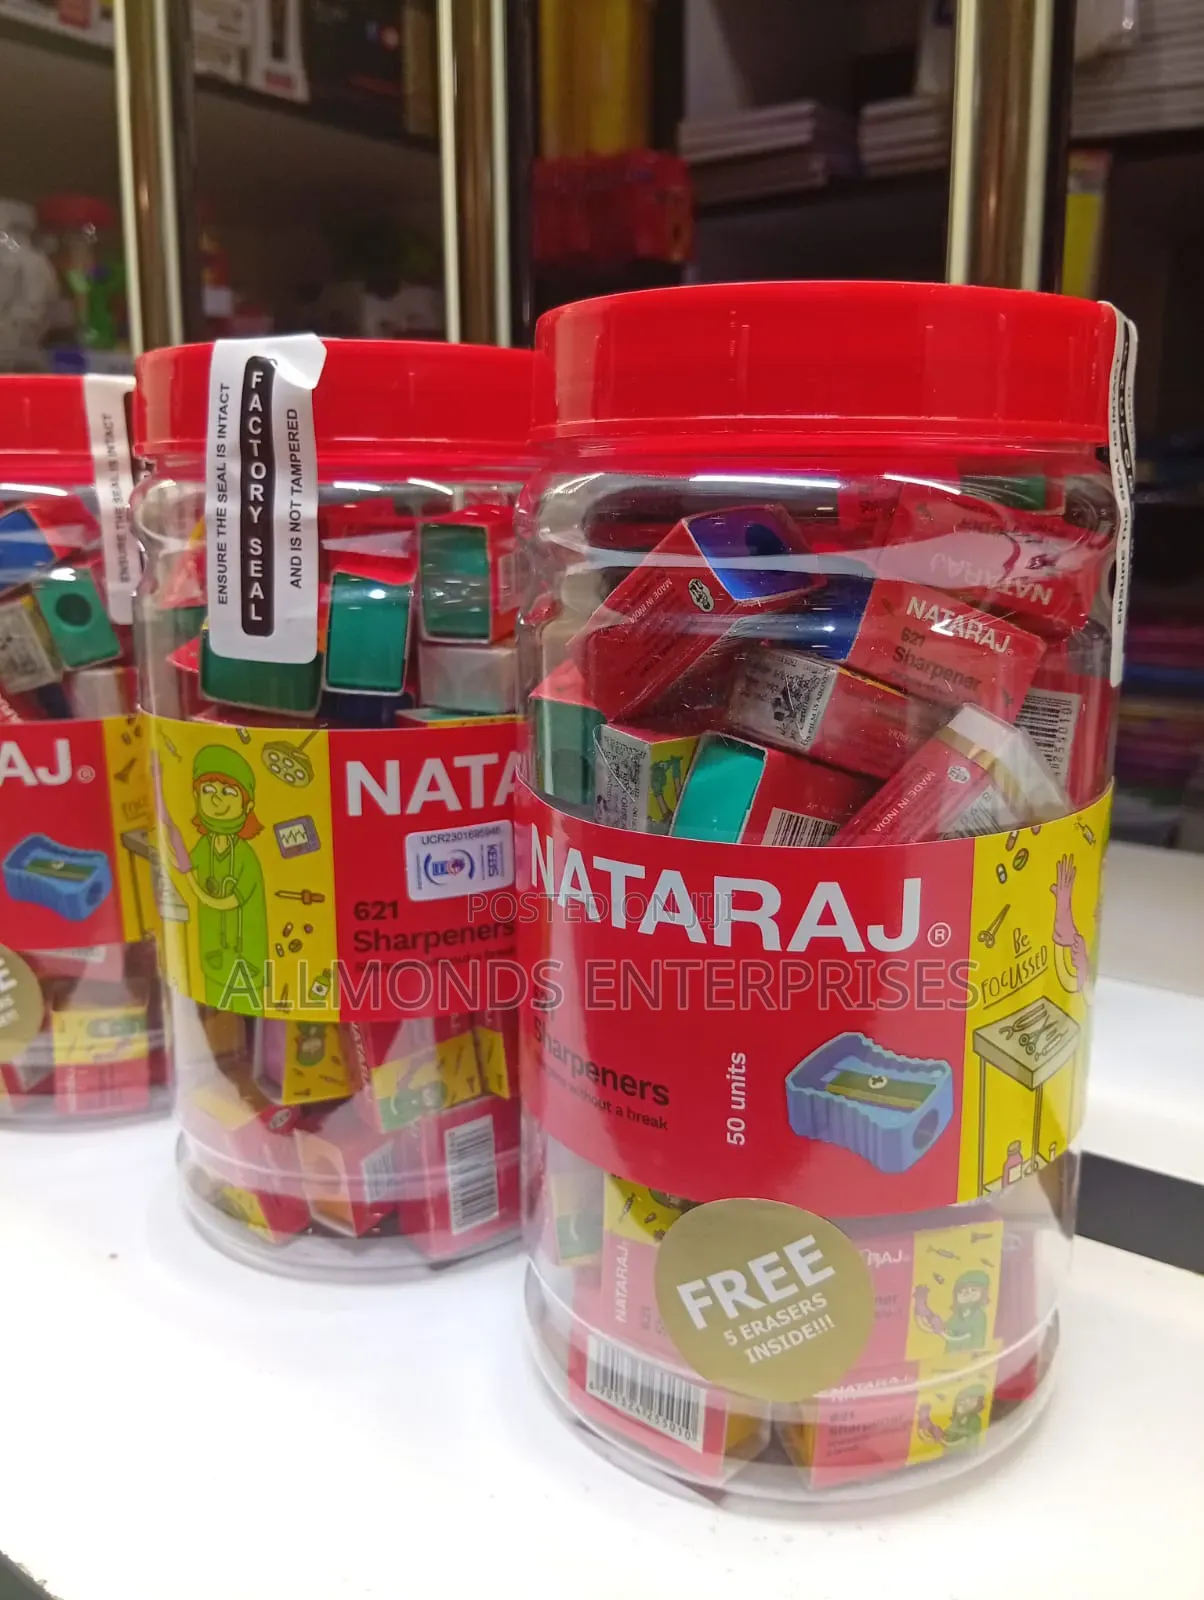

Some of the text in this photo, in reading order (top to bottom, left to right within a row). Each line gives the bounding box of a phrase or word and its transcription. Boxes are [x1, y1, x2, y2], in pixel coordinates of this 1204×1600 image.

[216, 383, 231, 606] ENSURE THE SEAL IS INTACT
[248, 370, 266, 622] FACTORY SEAL
[287, 408, 303, 589] AND IS NOT TAMPERED
[651, 576, 673, 599] MADE
[906, 596, 1011, 653] NATARAJ
[872, 767, 936, 836] MADE IN INDIA
[354, 900, 399, 921] 621
[530, 823, 922, 953] NATARAJ
[353, 922, 516, 954] Sharpeners
[1013, 927, 1030, 954] Be
[534, 1015, 671, 1106] Sharpeners
[615, 1105, 624, 1117] a
[626, 1107, 669, 1131] break
[725, 1052, 746, 1146] 50 units
[615, 1245, 630, 1323] NATARAJ
[676, 1234, 837, 1330] FREE
[723, 1293, 828, 1347] 5 ERASERS
[744, 1314, 836, 1365] INSIDE!!!
